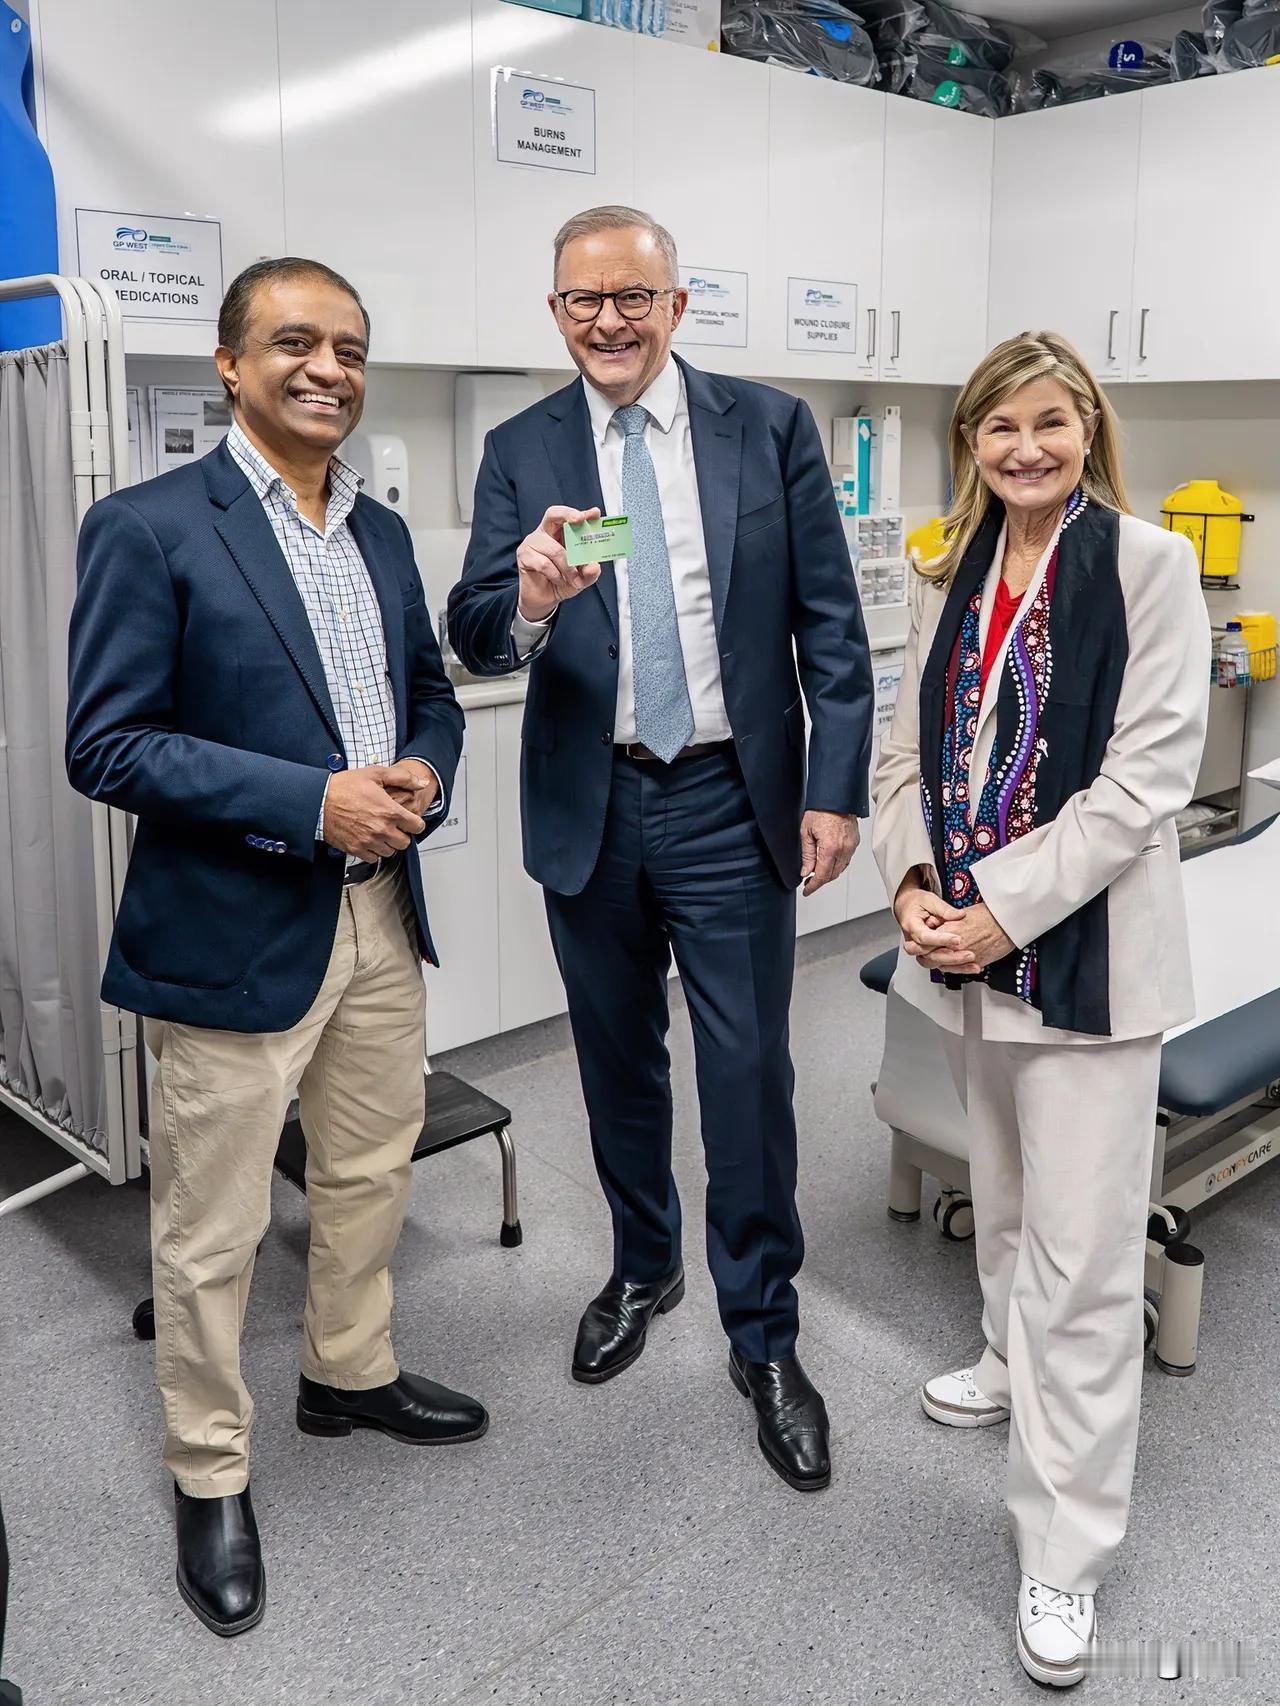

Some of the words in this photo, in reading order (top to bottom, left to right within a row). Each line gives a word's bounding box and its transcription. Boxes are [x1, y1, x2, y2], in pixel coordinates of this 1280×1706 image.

[534, 127, 566, 141] BURNS
[517, 139, 582, 158] MANAGEMENT
[113, 240, 125, 248] GP
[126, 242, 148, 250] WEST
[100, 268, 138, 283] ORAL
[142, 271, 146, 282] /
[148, 272, 205, 287] TOPICAL
[793, 318, 819, 329] WOUND
[820, 319, 851, 330] CLOSURE
[807, 331, 839, 342] SUPPLIES
